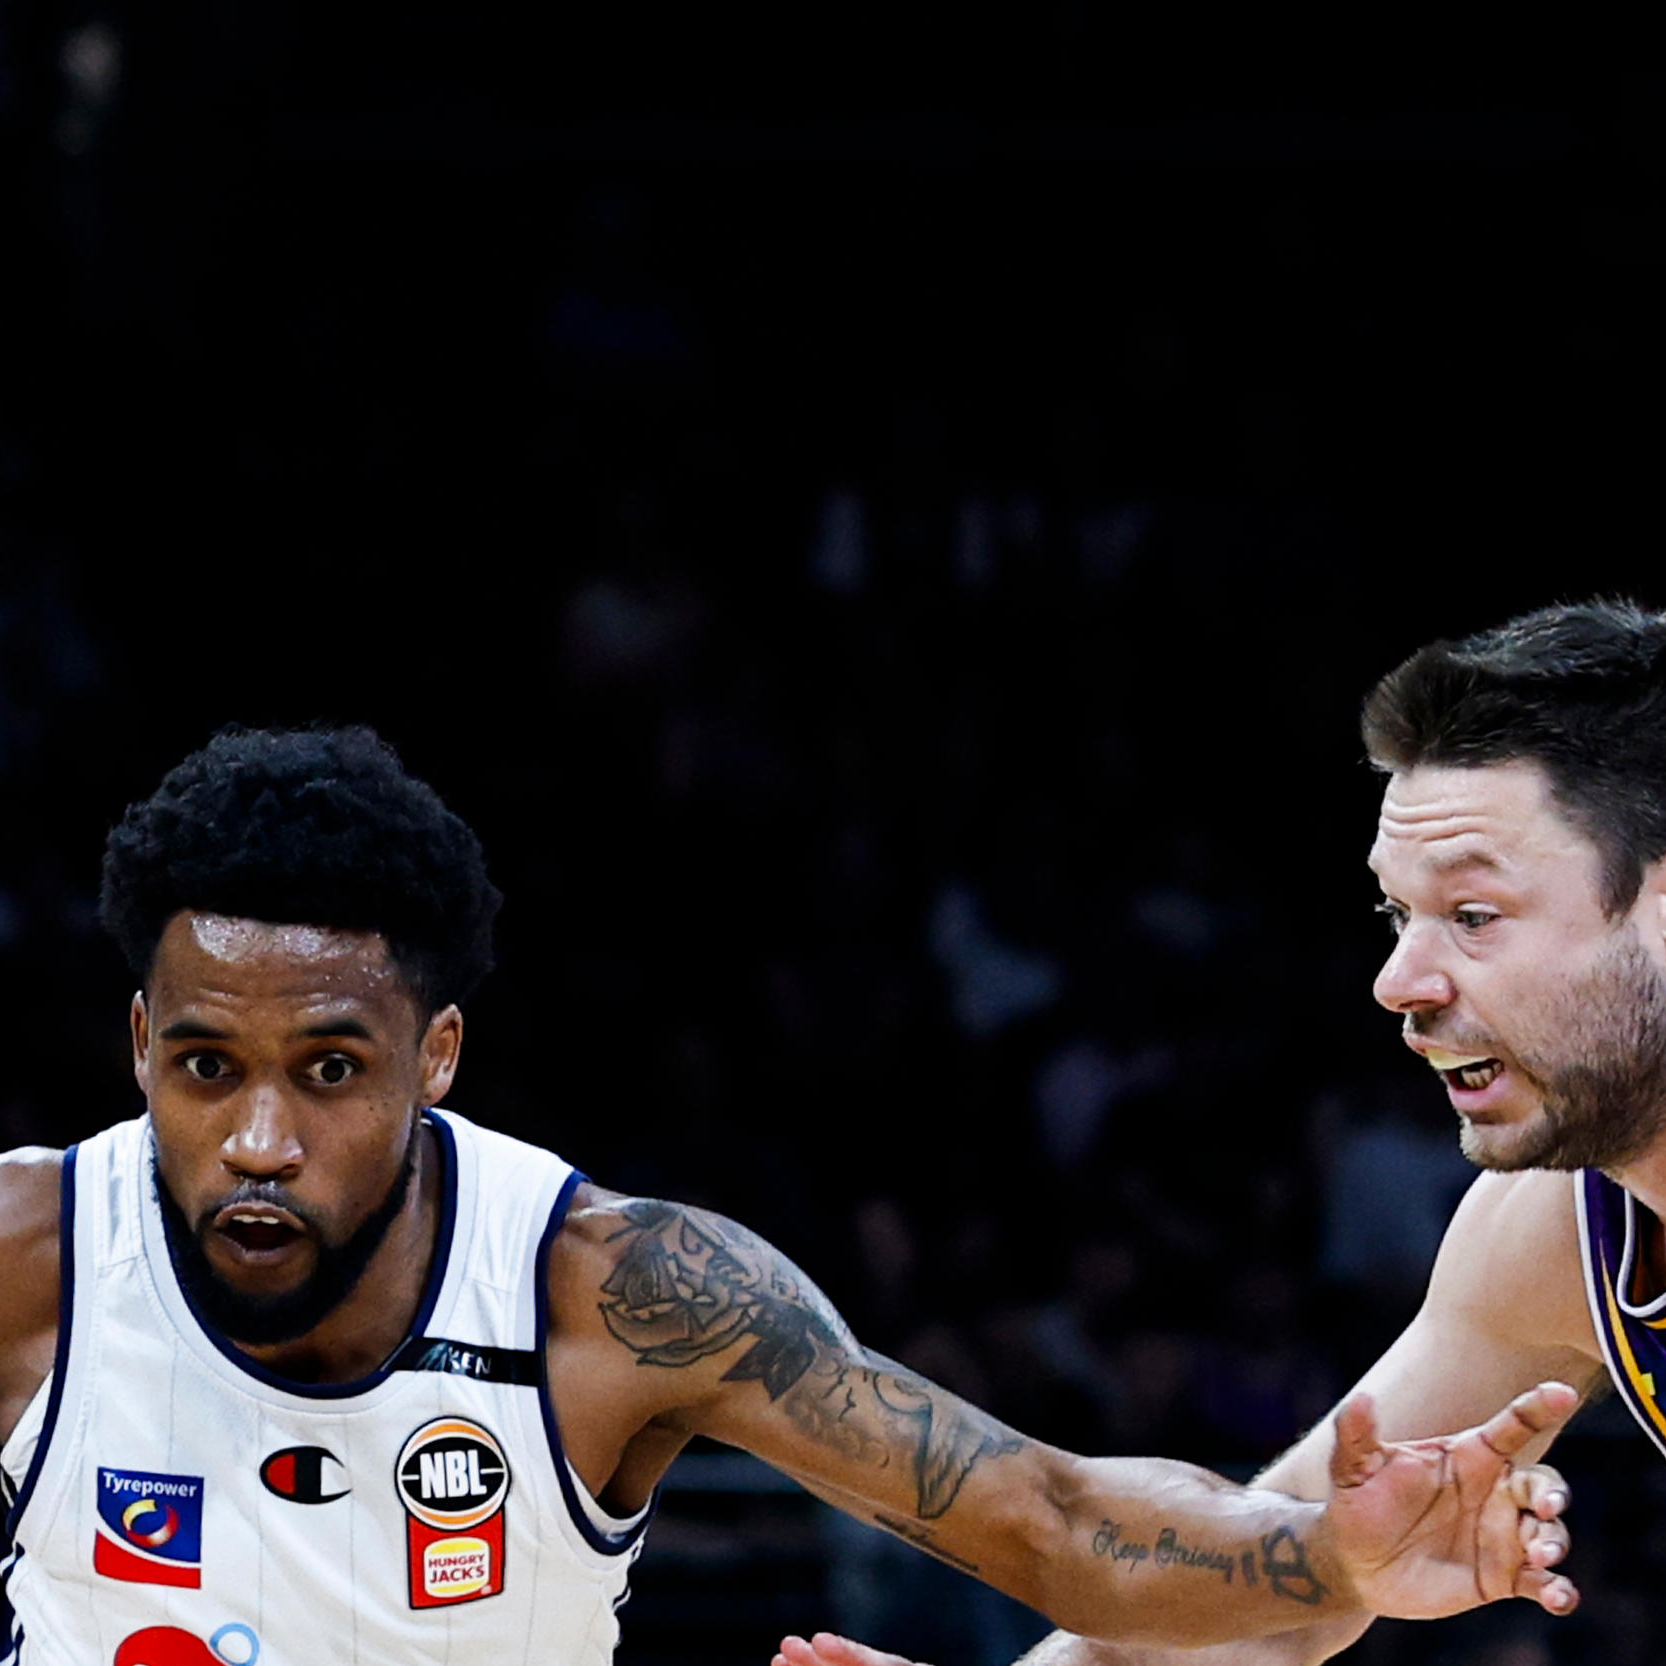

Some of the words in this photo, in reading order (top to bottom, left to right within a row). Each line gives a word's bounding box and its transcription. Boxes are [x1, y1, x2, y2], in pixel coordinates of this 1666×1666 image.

[102, 1471, 198, 1498] Tyrepower
[419, 1448, 488, 1500] NBL
[428, 1553, 485, 1569] HUNGRY
